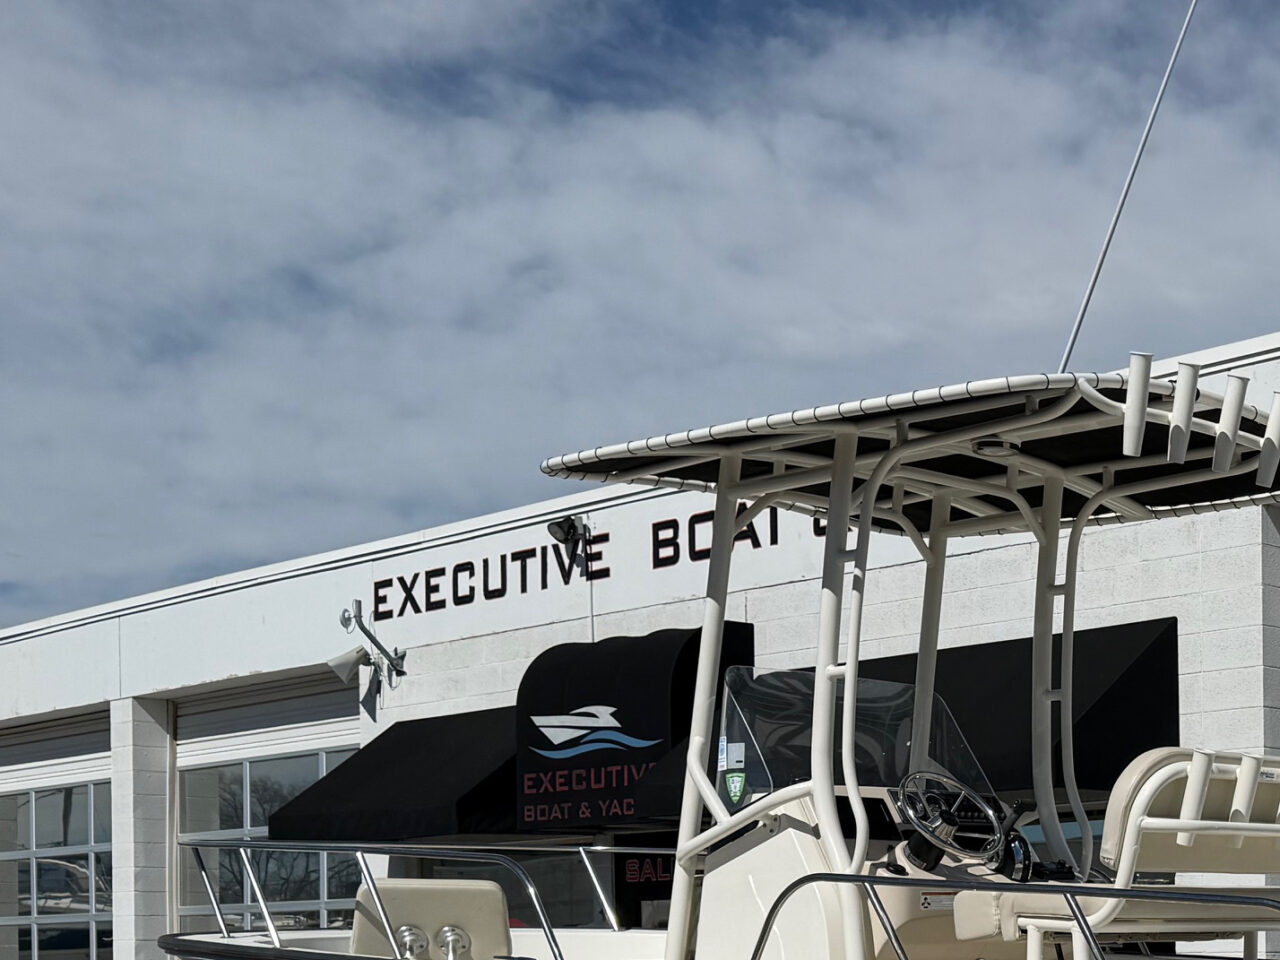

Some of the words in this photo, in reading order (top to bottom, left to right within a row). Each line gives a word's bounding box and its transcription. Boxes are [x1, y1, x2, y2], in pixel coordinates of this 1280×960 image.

[373, 532, 611, 622] EXECUTIVE
[523, 762, 656, 794] EXECUTIV
[524, 802, 571, 822] BOAT
[579, 803, 592, 818] &
[599, 799, 635, 817] YAC
[625, 858, 675, 882] SAL
